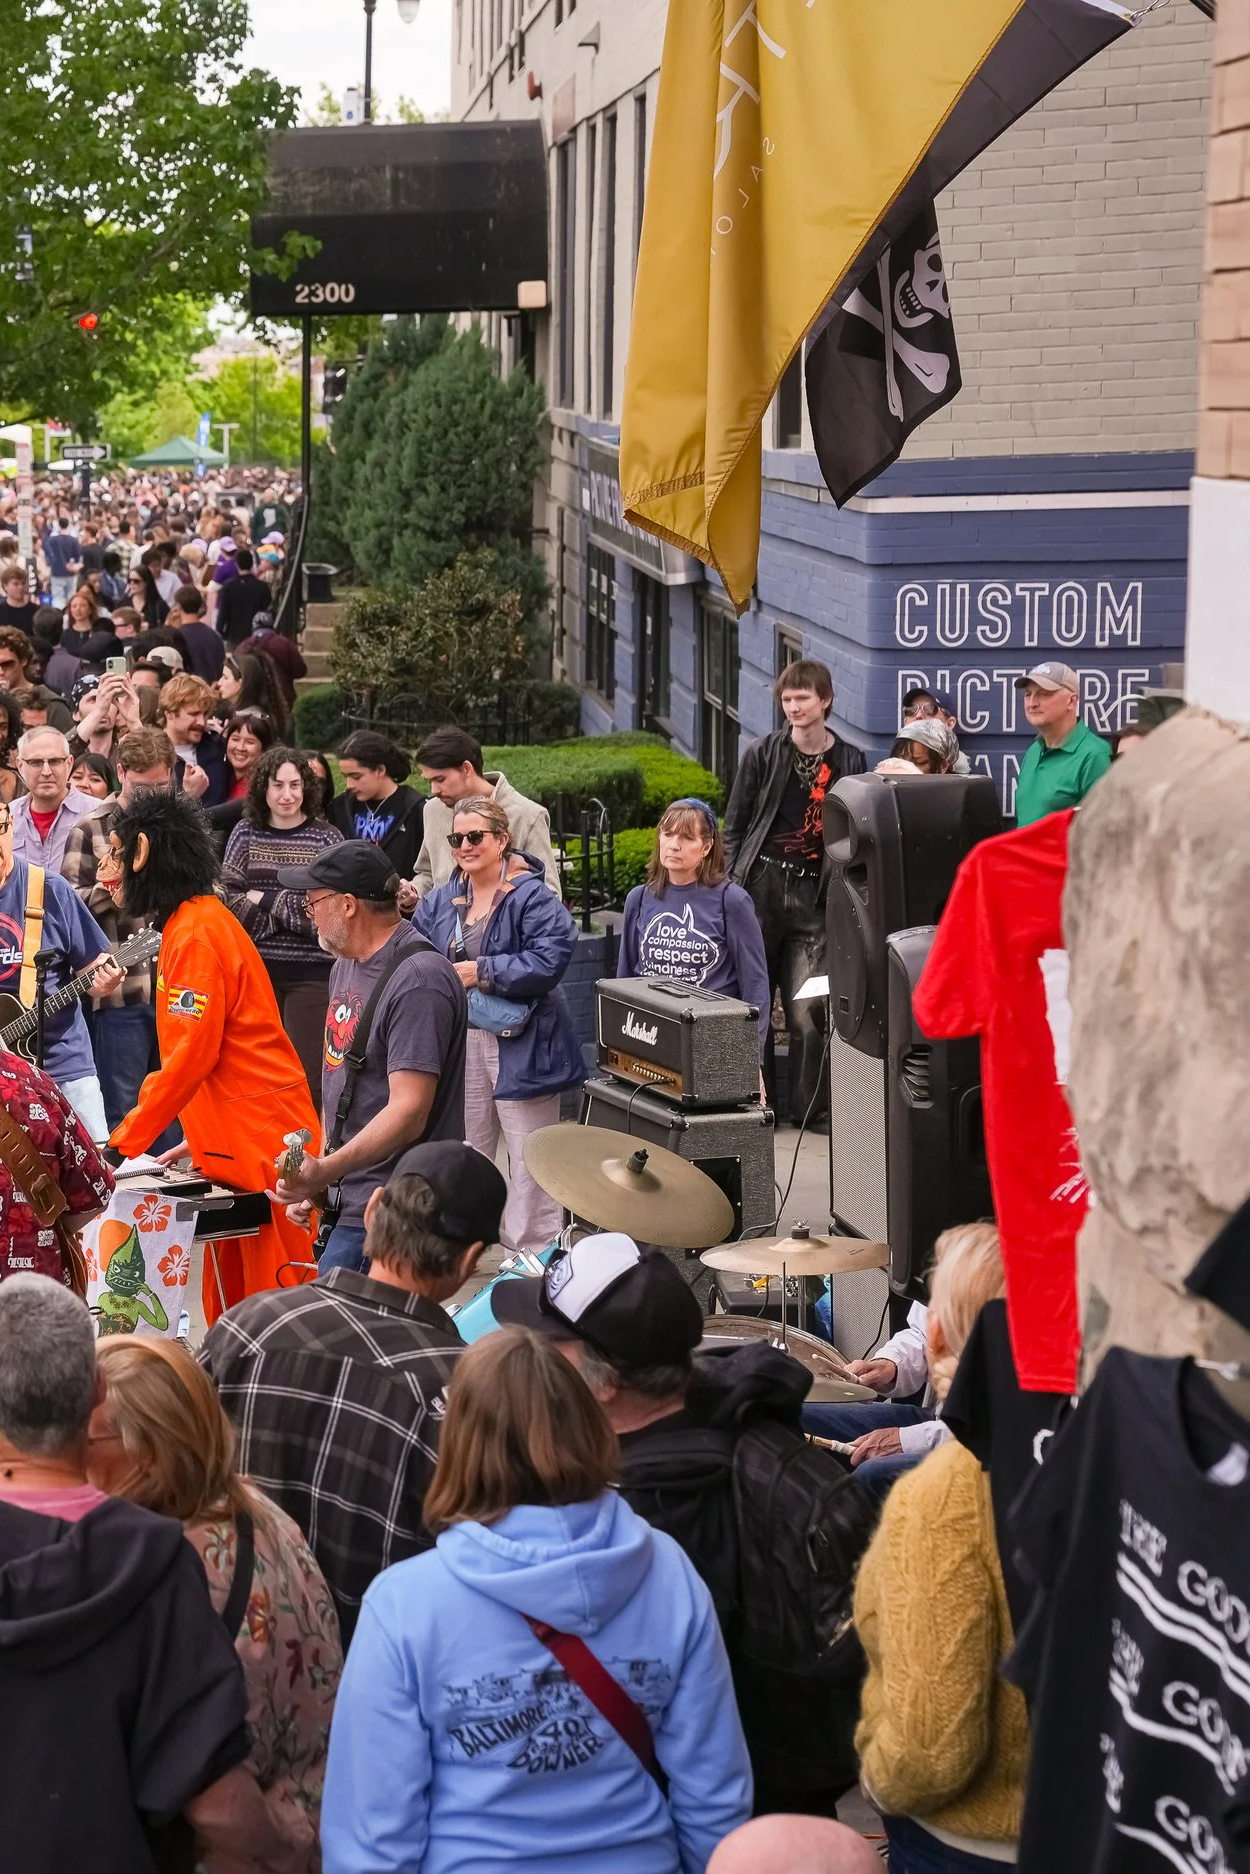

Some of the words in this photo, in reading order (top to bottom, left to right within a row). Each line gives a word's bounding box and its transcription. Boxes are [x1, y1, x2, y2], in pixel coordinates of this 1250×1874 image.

[295, 282, 355, 303] 2300
[895, 581, 1143, 648] CUSTOM
[897, 668, 1149, 733] PCTRE
[647, 936, 709, 950] compassion
[656, 921, 688, 939] love
[648, 947, 709, 964] respect
[621, 1011, 658, 1046] Marshall
[1177, 1560, 1250, 1660] GOO
[452, 1700, 548, 1759] BALTIMORE
[507, 1736, 606, 1775] DOWNER
